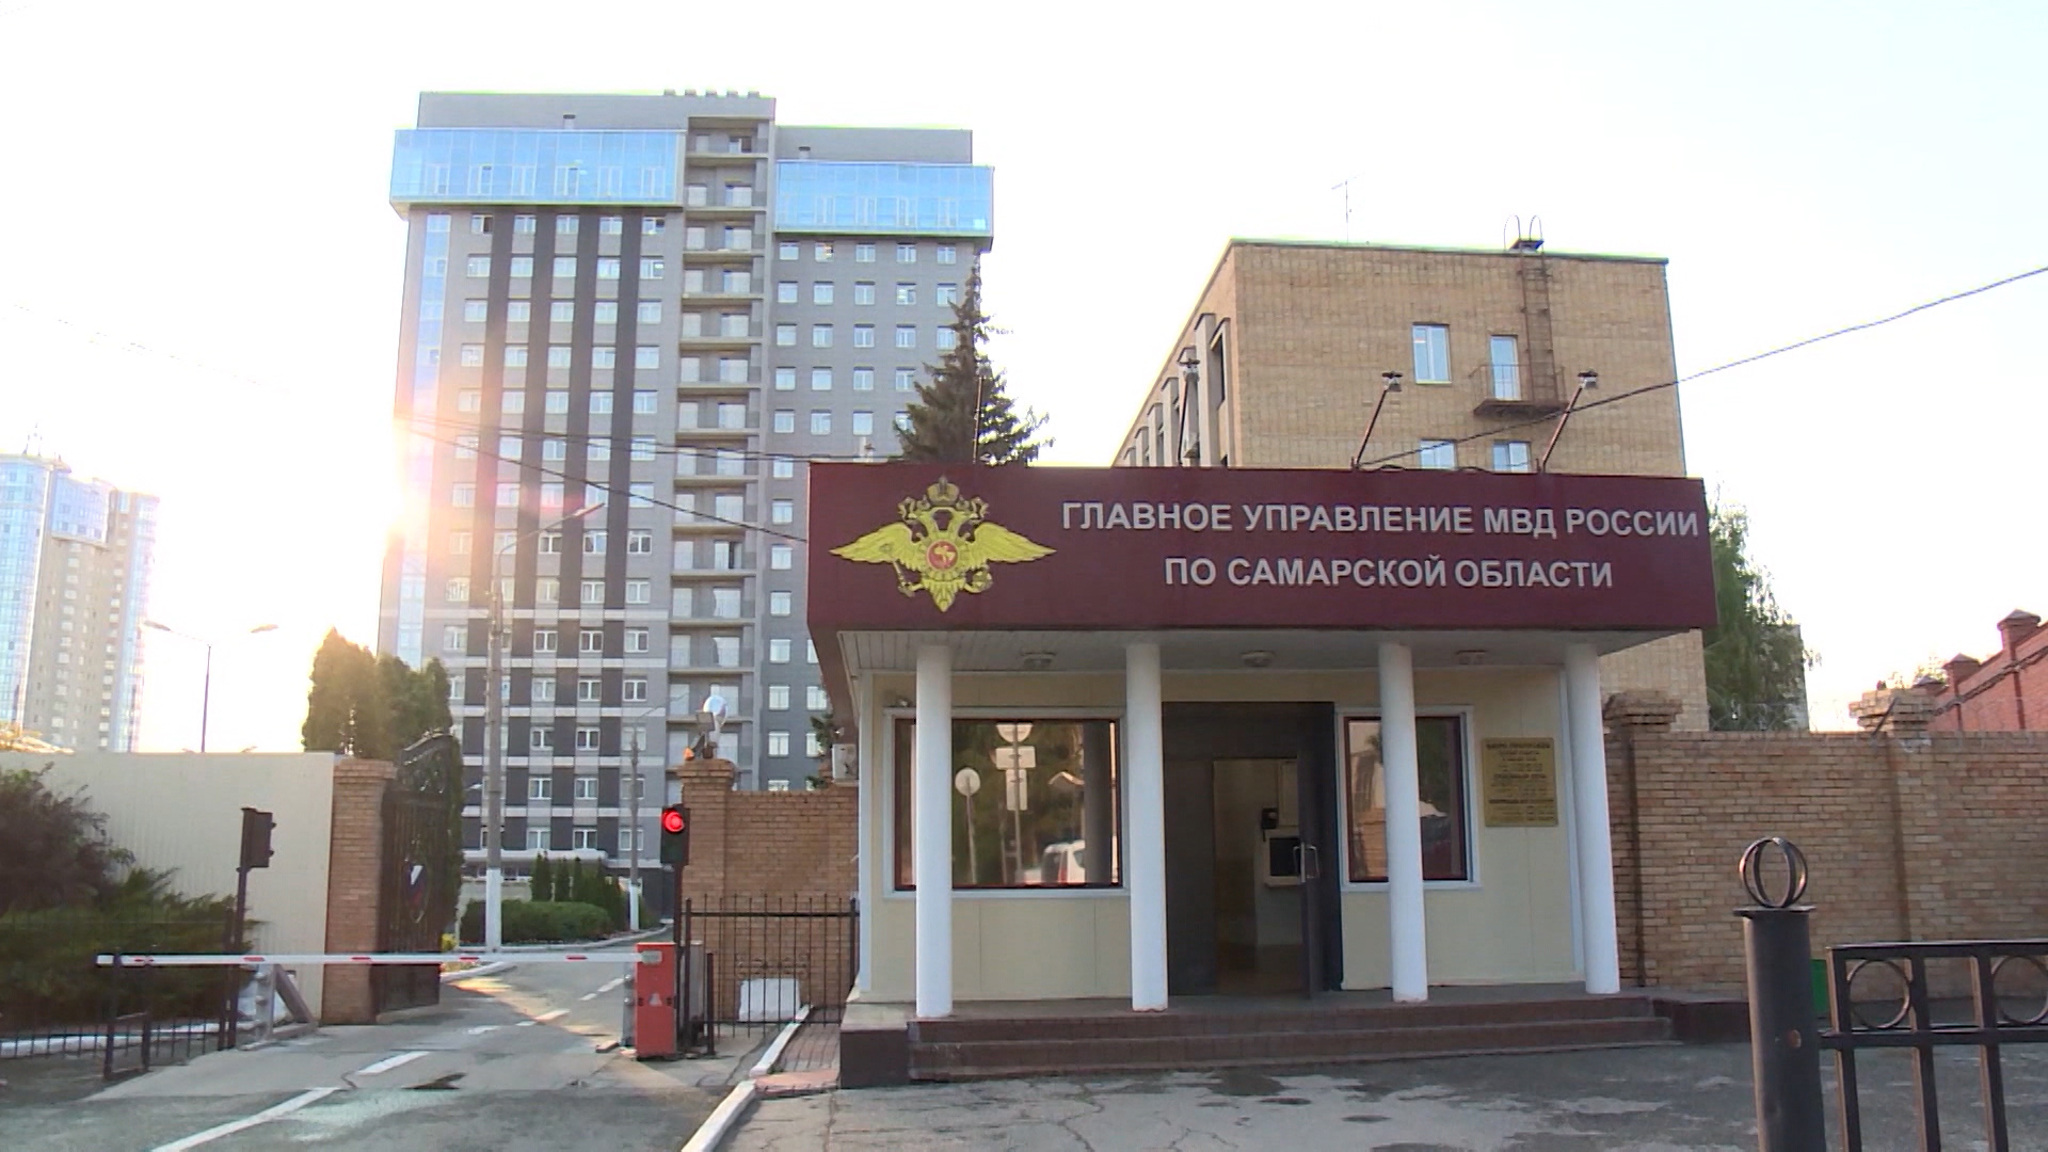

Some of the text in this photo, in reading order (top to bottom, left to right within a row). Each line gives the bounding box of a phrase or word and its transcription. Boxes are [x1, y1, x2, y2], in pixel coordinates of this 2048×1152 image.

[1062, 502, 1699, 539] ГЛАВНОЕ УПРАВЛЕНИЕ МВД РОССИИ
[1165, 554, 1613, 588] ПО САМАРСКОЙ ОБЛАСТИ
